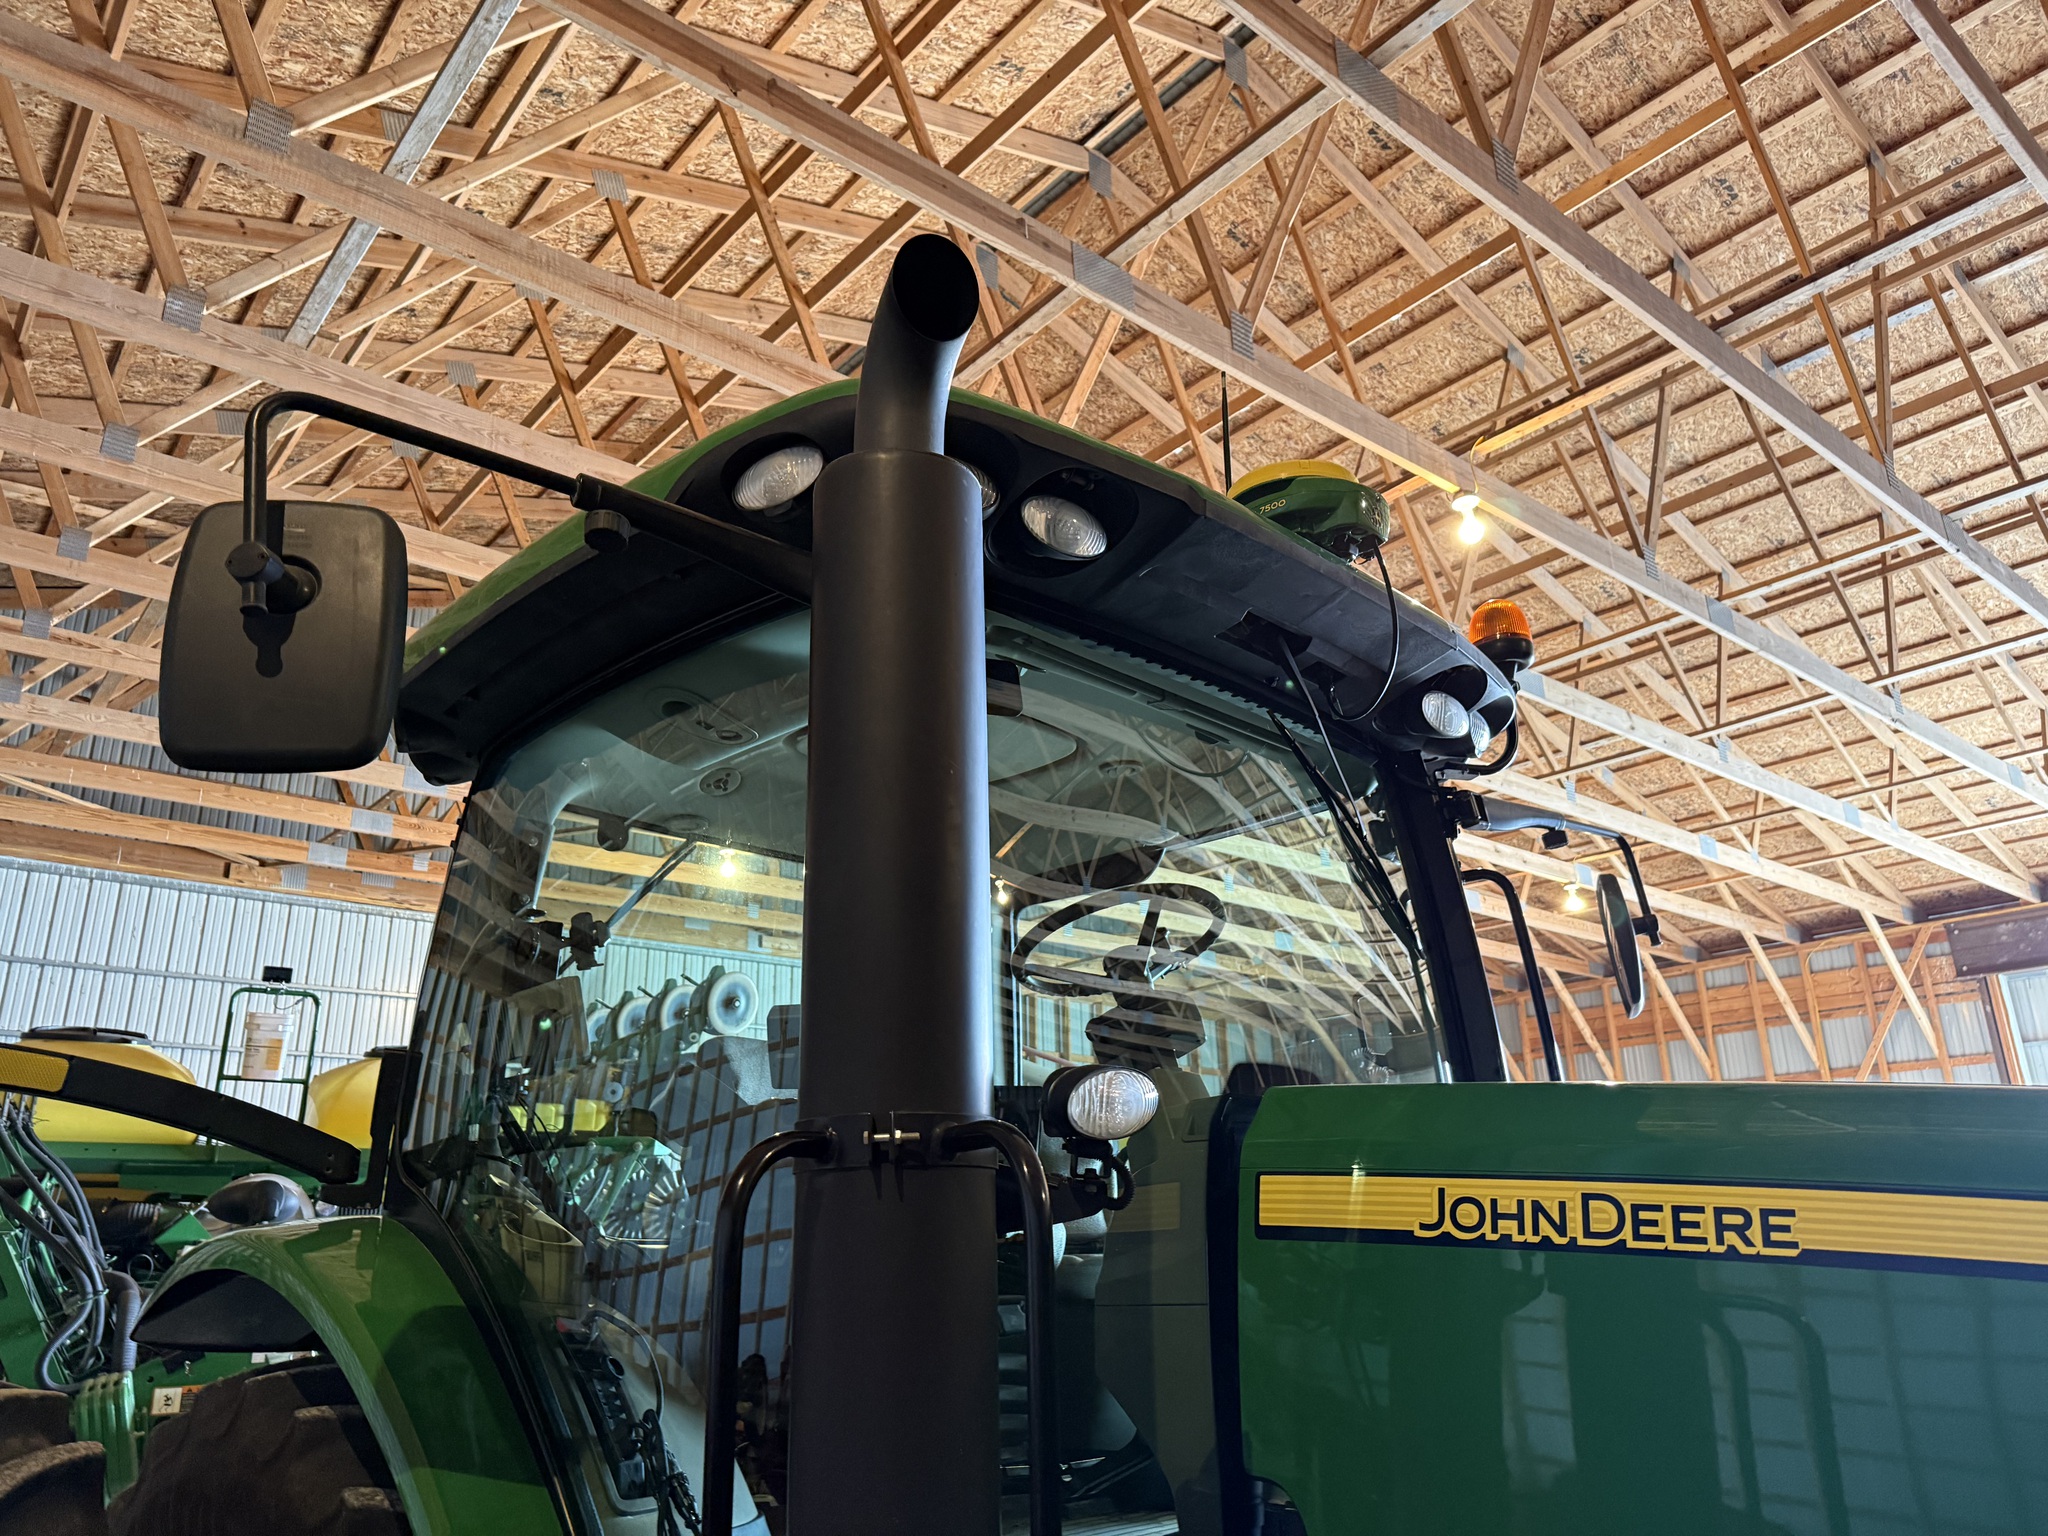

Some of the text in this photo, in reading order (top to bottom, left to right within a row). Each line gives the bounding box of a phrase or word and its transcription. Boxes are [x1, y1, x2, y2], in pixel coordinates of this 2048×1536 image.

[1259, 499, 1286, 514] 7500
[1417, 1186, 1801, 1252] JOHN DEERE
